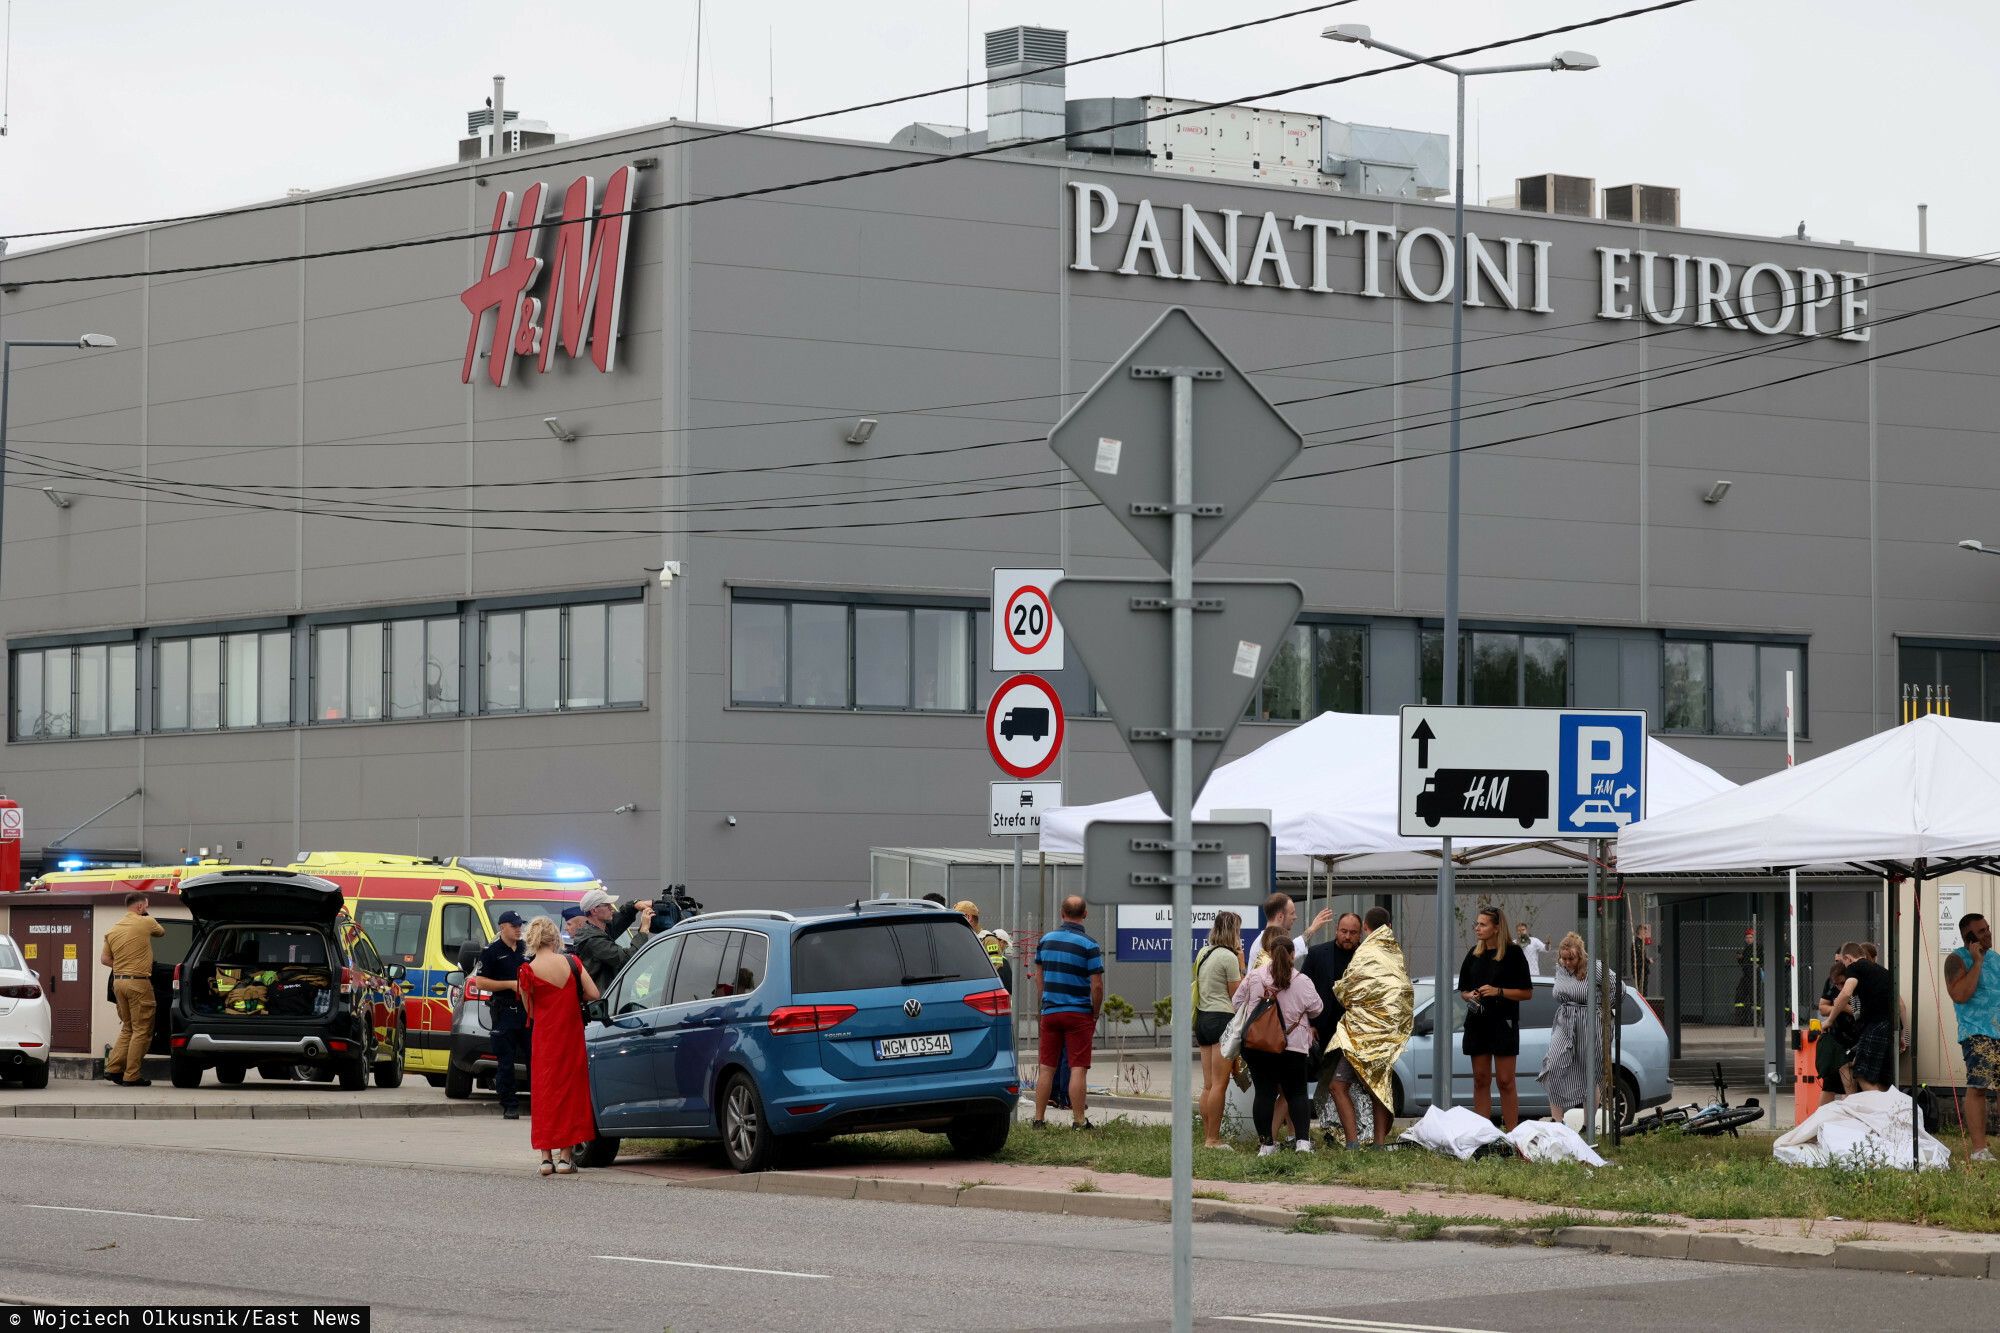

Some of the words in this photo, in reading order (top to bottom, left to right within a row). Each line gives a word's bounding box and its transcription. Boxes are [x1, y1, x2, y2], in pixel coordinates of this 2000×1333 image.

[461, 166, 636, 387] H&M
[1068, 182, 1554, 313] PANATTONI
[1596, 246, 1870, 342] EUROPE
[1013, 604, 1043, 635] 20
[1577, 726, 1623, 795] P
[1463, 776, 1509, 812] H&M
[1594, 779, 1614, 795] H&M
[993, 812, 1026, 827] Strefa
[1155, 909, 1165, 921] ul.
[882, 1040, 908, 1055] WGM
[910, 1036, 950, 1051] 0354A
